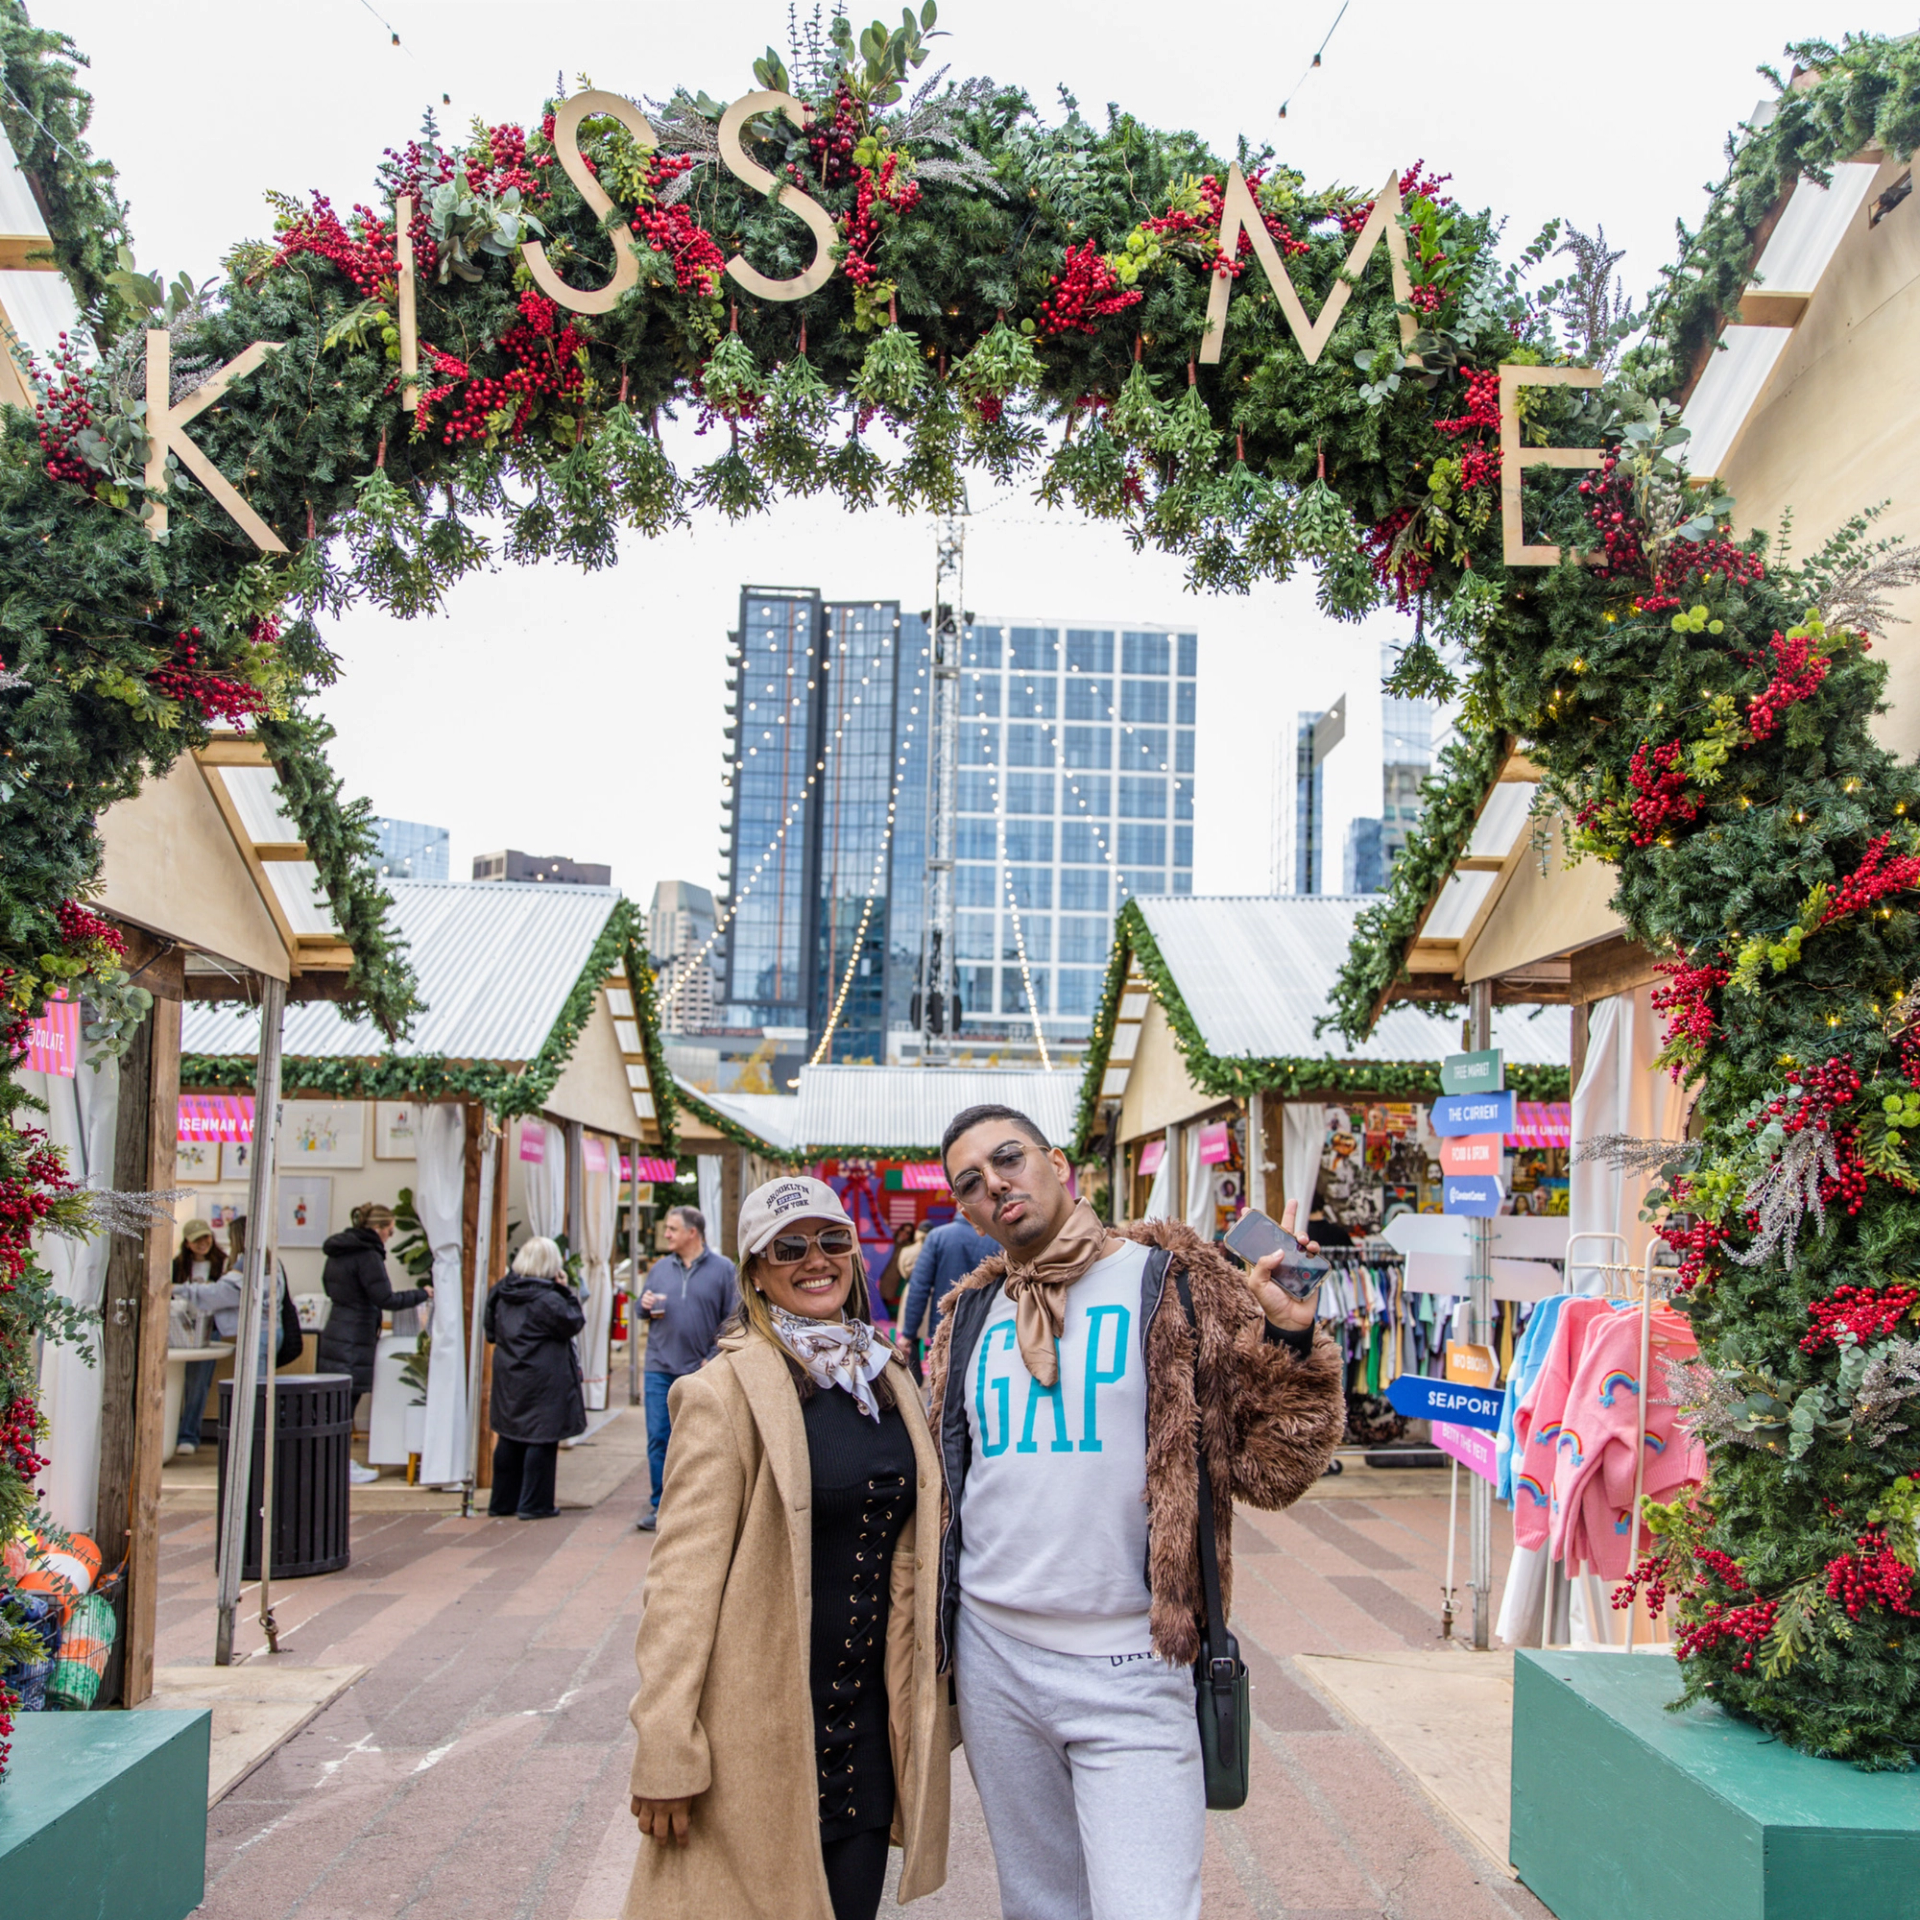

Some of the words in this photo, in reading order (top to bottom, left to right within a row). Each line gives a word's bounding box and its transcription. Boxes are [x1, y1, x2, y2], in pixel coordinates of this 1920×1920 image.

[144, 89, 839, 554] KISS
[1199, 160, 1608, 567] ME
[1468, 1062, 1490, 1079] MARKET
[1448, 1107, 1462, 1122] THE
[1463, 1104, 1499, 1121] CURRENT
[179, 1118, 236, 1131] ISENMAN
[1451, 1147, 1466, 1162] FOOD
[766, 1183, 810, 1209] BROOKLYN
[774, 1203, 790, 1216] NEW
[790, 1199, 810, 1208] YORK
[1452, 1353, 1466, 1369] INFO
[1466, 1355, 1488, 1373] BOOTH
[976, 1304, 1131, 1458] GAP
[1427, 1391, 1499, 1417] SEAPORT
[1442, 1422, 1460, 1445] BETTY
[1460, 1434, 1472, 1454] THE
[1472, 1443, 1488, 1464] YETI
